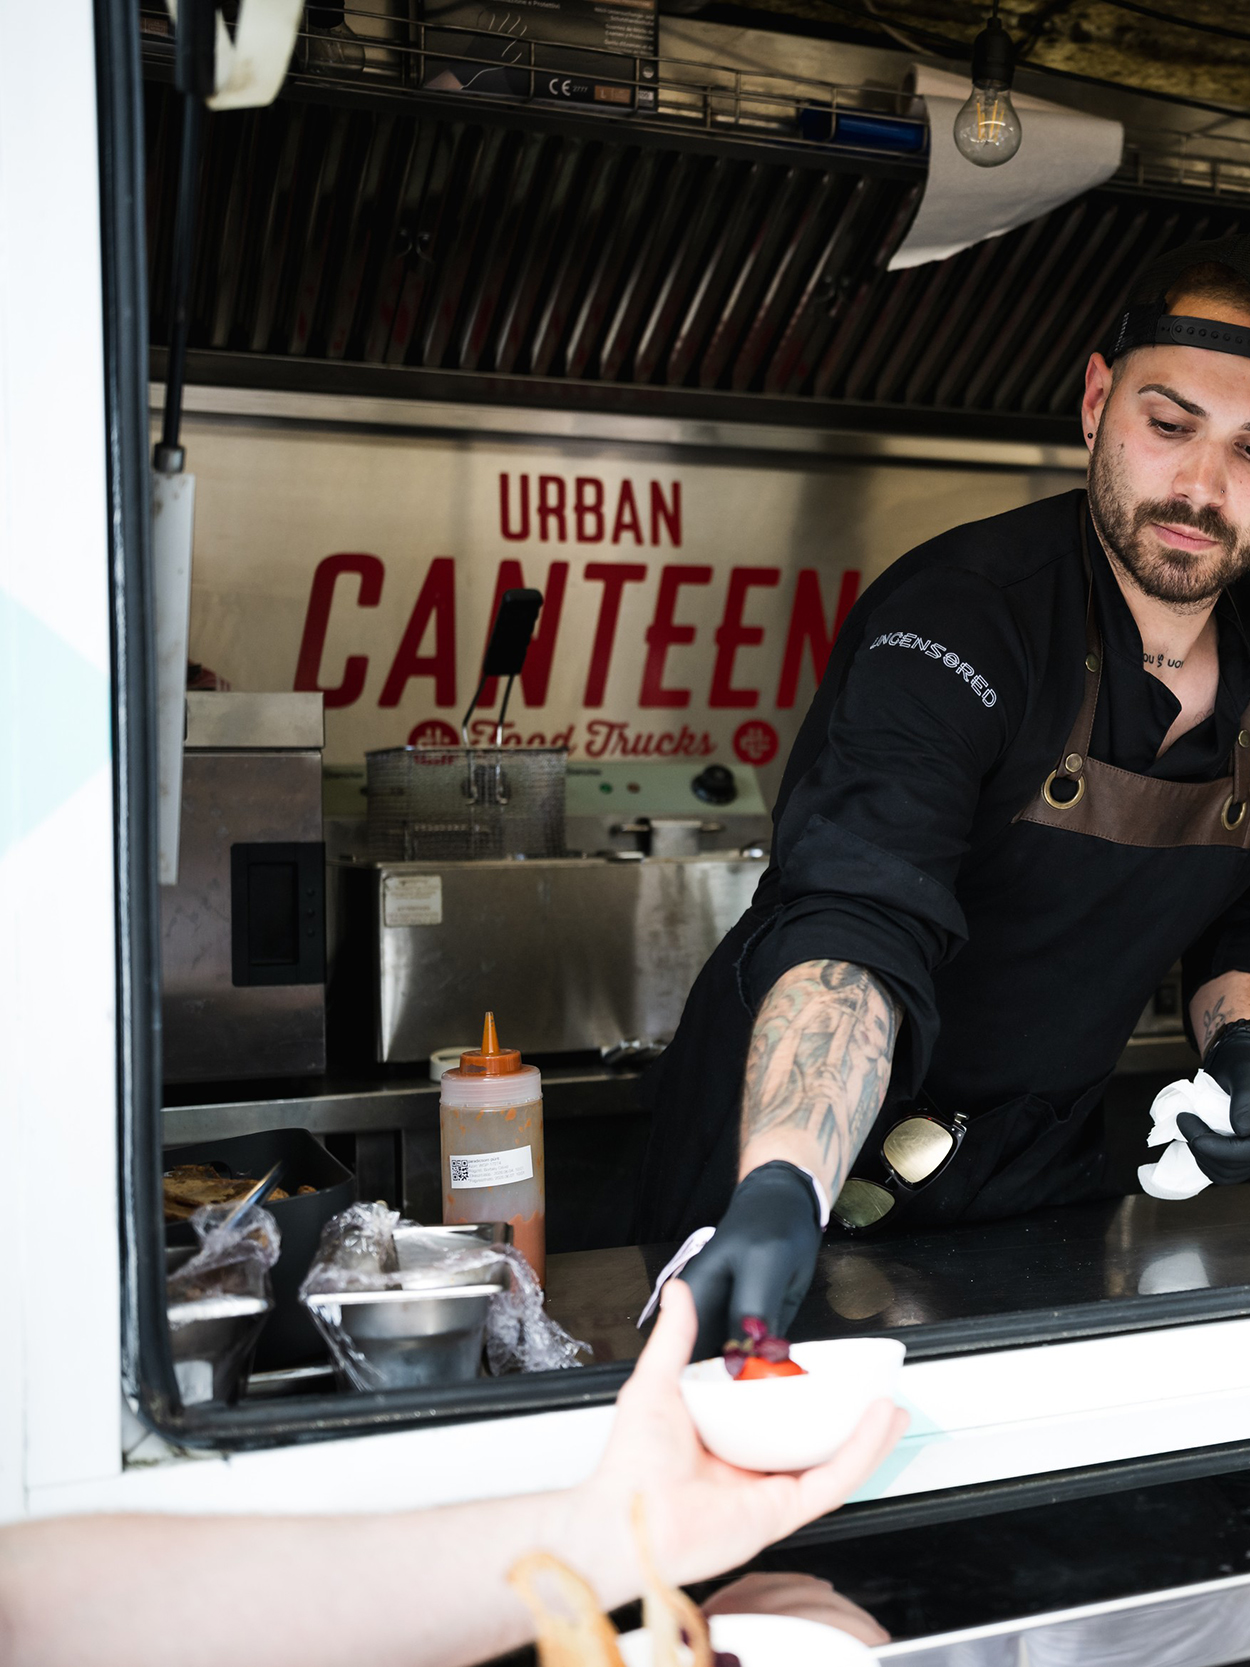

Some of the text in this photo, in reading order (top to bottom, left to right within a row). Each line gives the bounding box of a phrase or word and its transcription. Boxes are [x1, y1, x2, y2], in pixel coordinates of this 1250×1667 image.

[498, 471, 683, 548] URBAN
[291, 552, 862, 710] CANTEEN
[585, 719, 718, 758] Trucks
